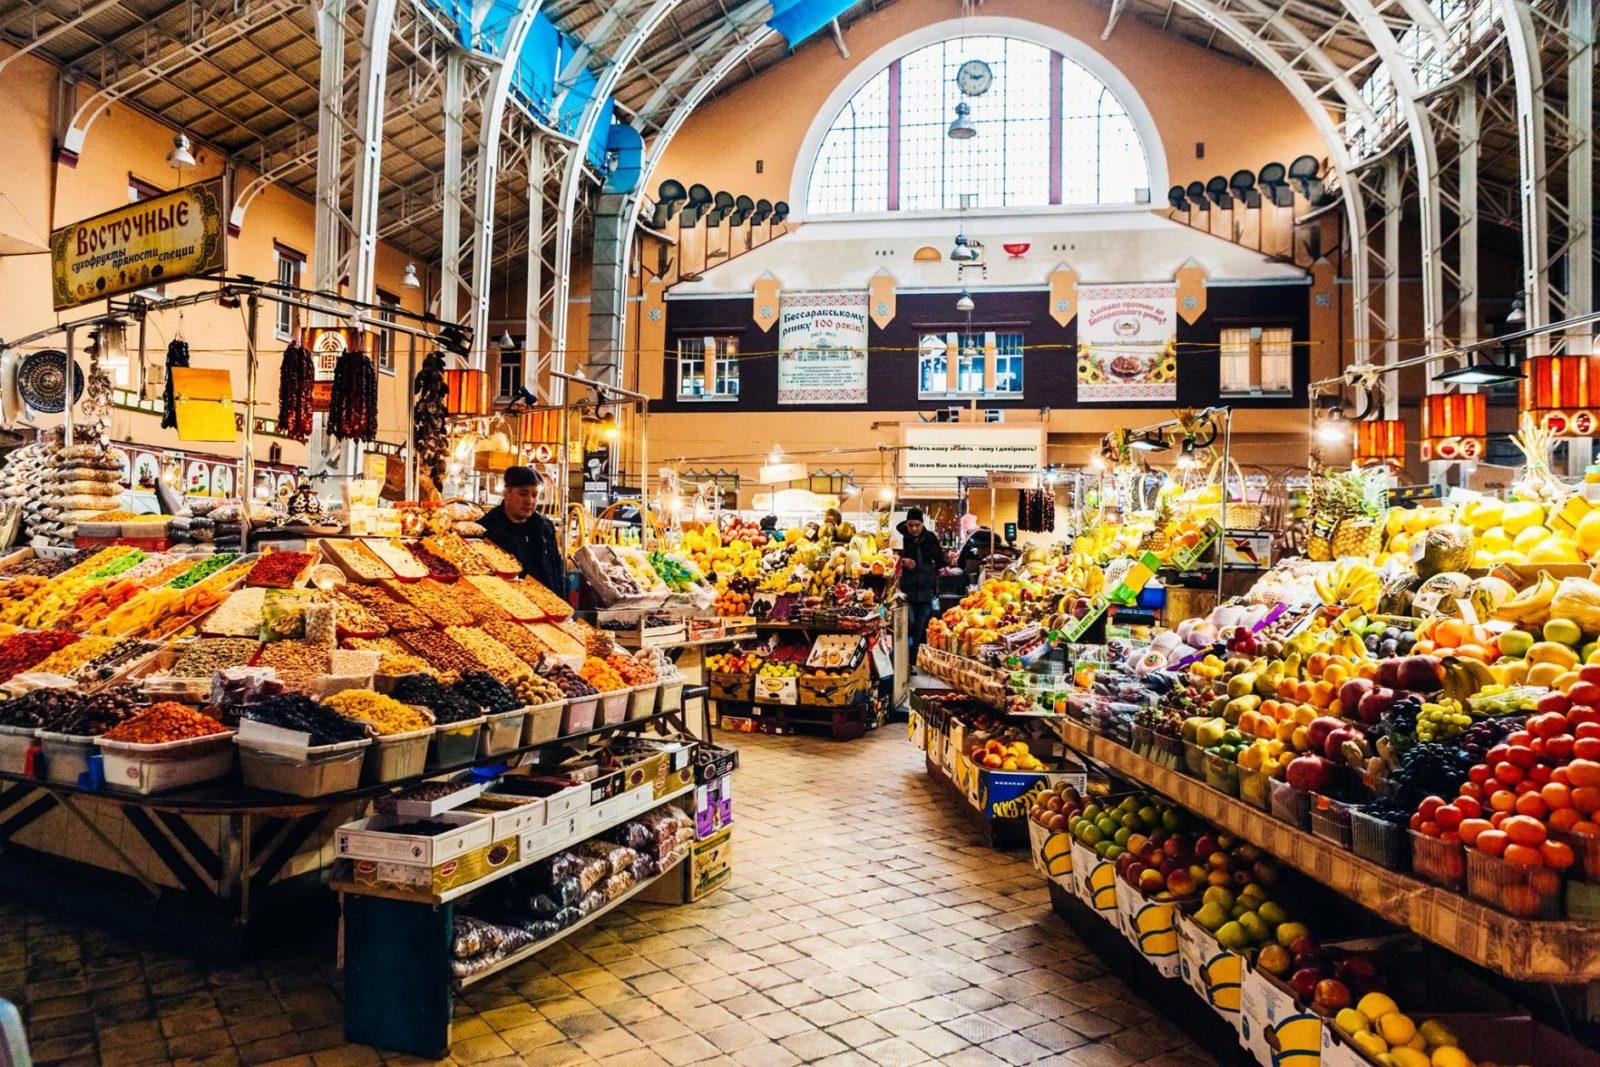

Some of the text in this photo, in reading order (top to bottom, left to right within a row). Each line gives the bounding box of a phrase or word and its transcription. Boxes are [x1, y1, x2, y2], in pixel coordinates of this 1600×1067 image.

[76, 201, 189, 256] Восточные
[71, 248, 127, 273] сухофрукты
[112, 248, 159, 269] пряности
[158, 245, 195, 262] специи
[782, 322, 812, 337] ринку
[815, 319, 833, 328] 100
